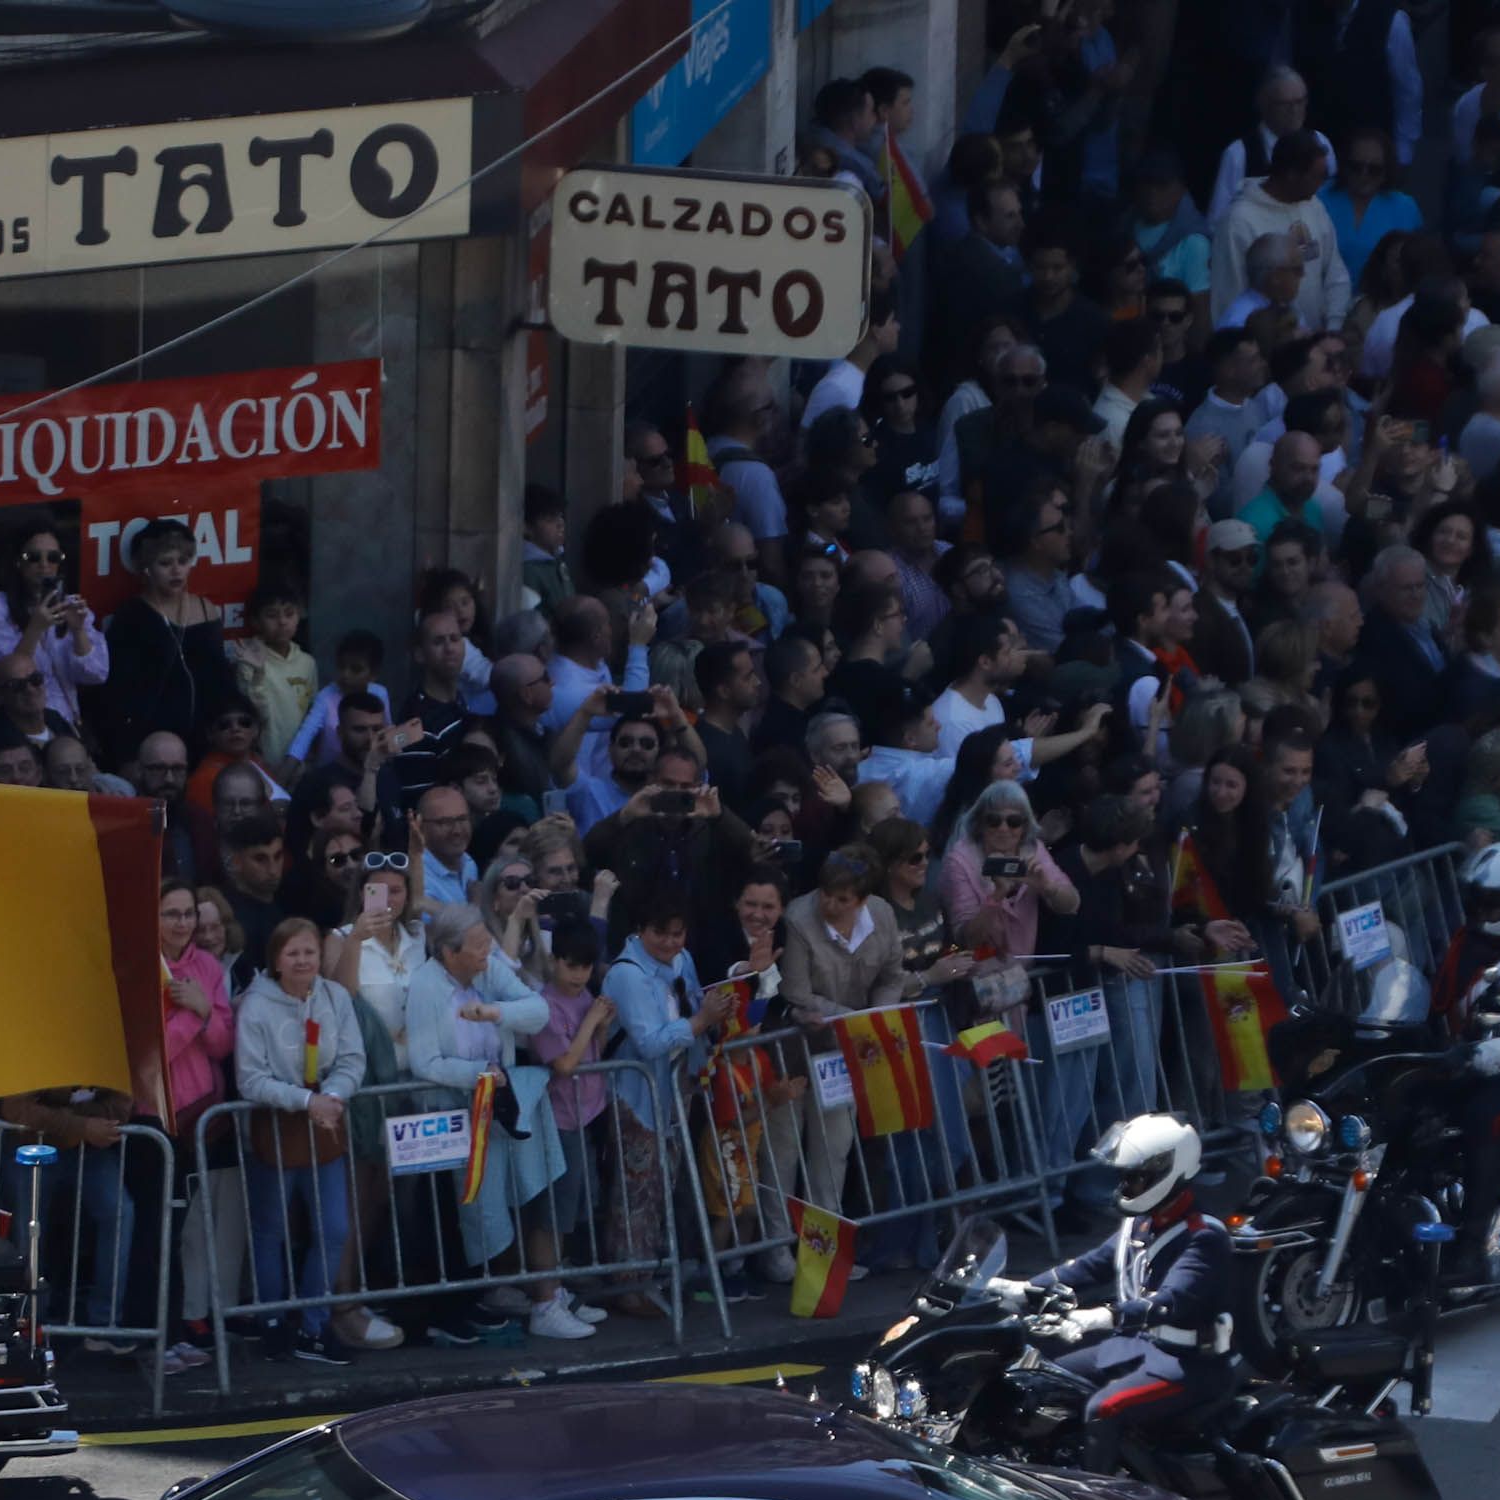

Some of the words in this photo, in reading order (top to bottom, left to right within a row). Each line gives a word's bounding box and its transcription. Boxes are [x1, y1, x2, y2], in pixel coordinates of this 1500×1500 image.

[51, 122, 440, 246] TATO
[569, 190, 846, 243] CALZADOS
[583, 257, 824, 338] TATO
[88, 509, 253, 577] TOAL
[1050, 991, 1101, 1021] VYCAS
[393, 1115, 464, 1142] VYCAS
